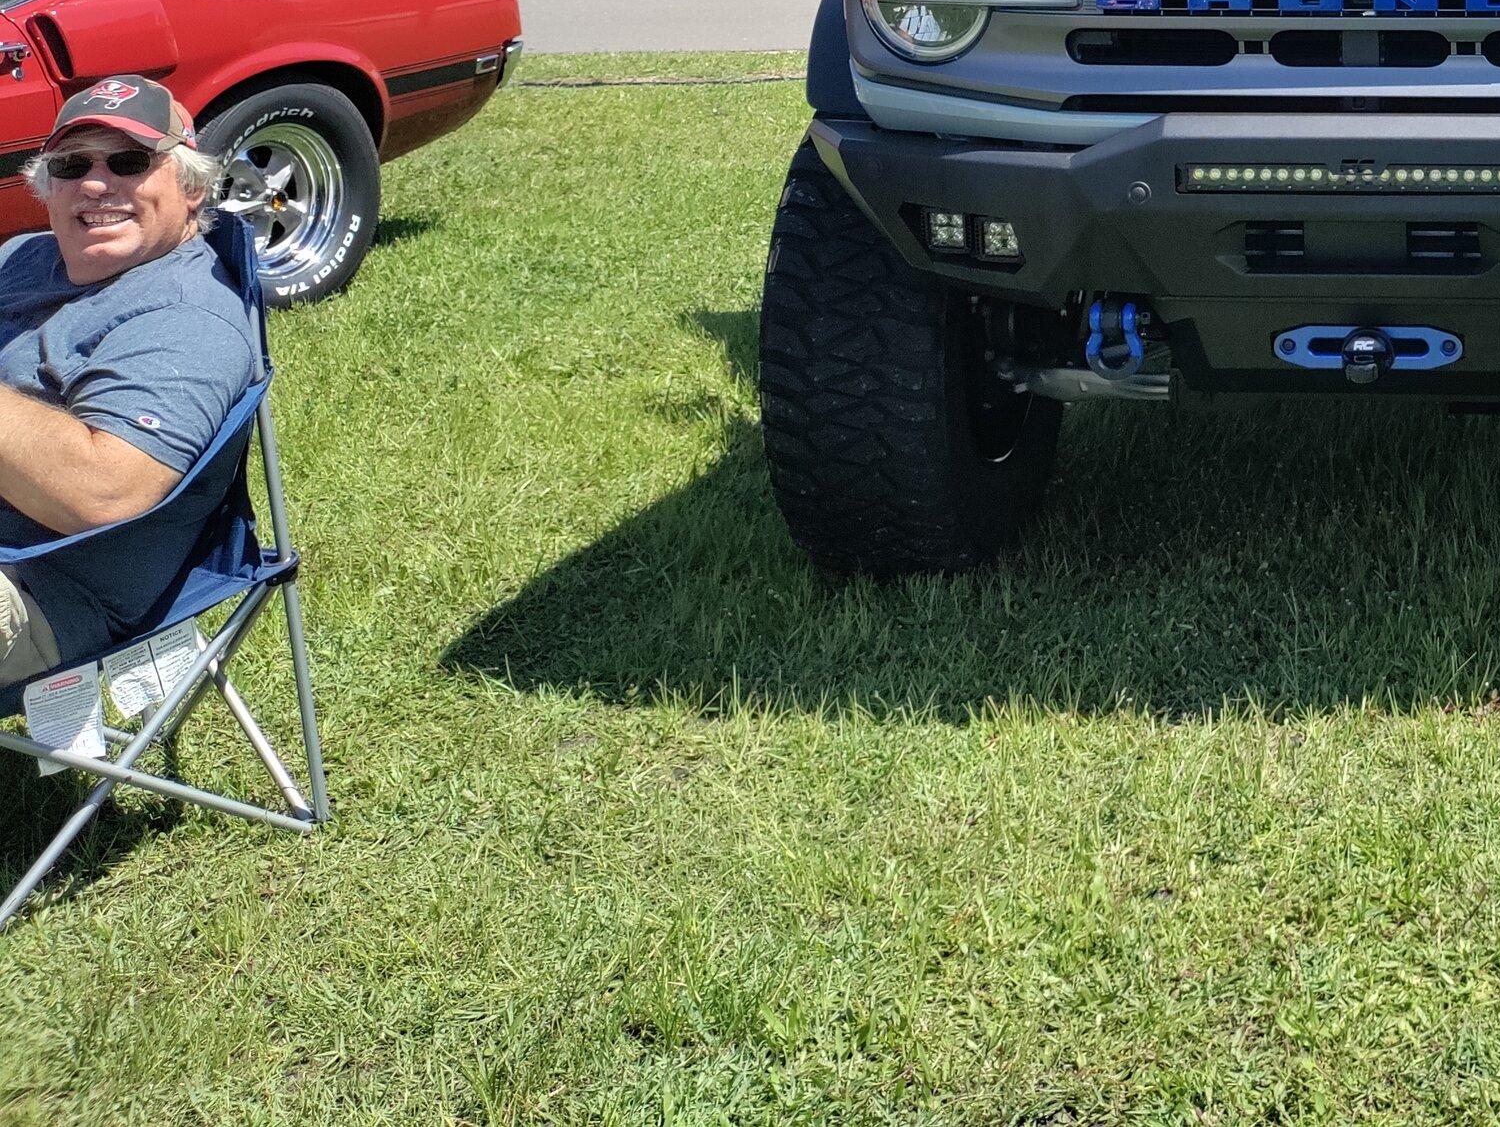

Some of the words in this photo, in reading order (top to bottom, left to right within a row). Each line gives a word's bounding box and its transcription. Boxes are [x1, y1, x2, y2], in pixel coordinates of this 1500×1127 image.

[313, 214, 362, 285] Radial
[275, 281, 311, 296] T/A
[1353, 340, 1375, 351] RC
